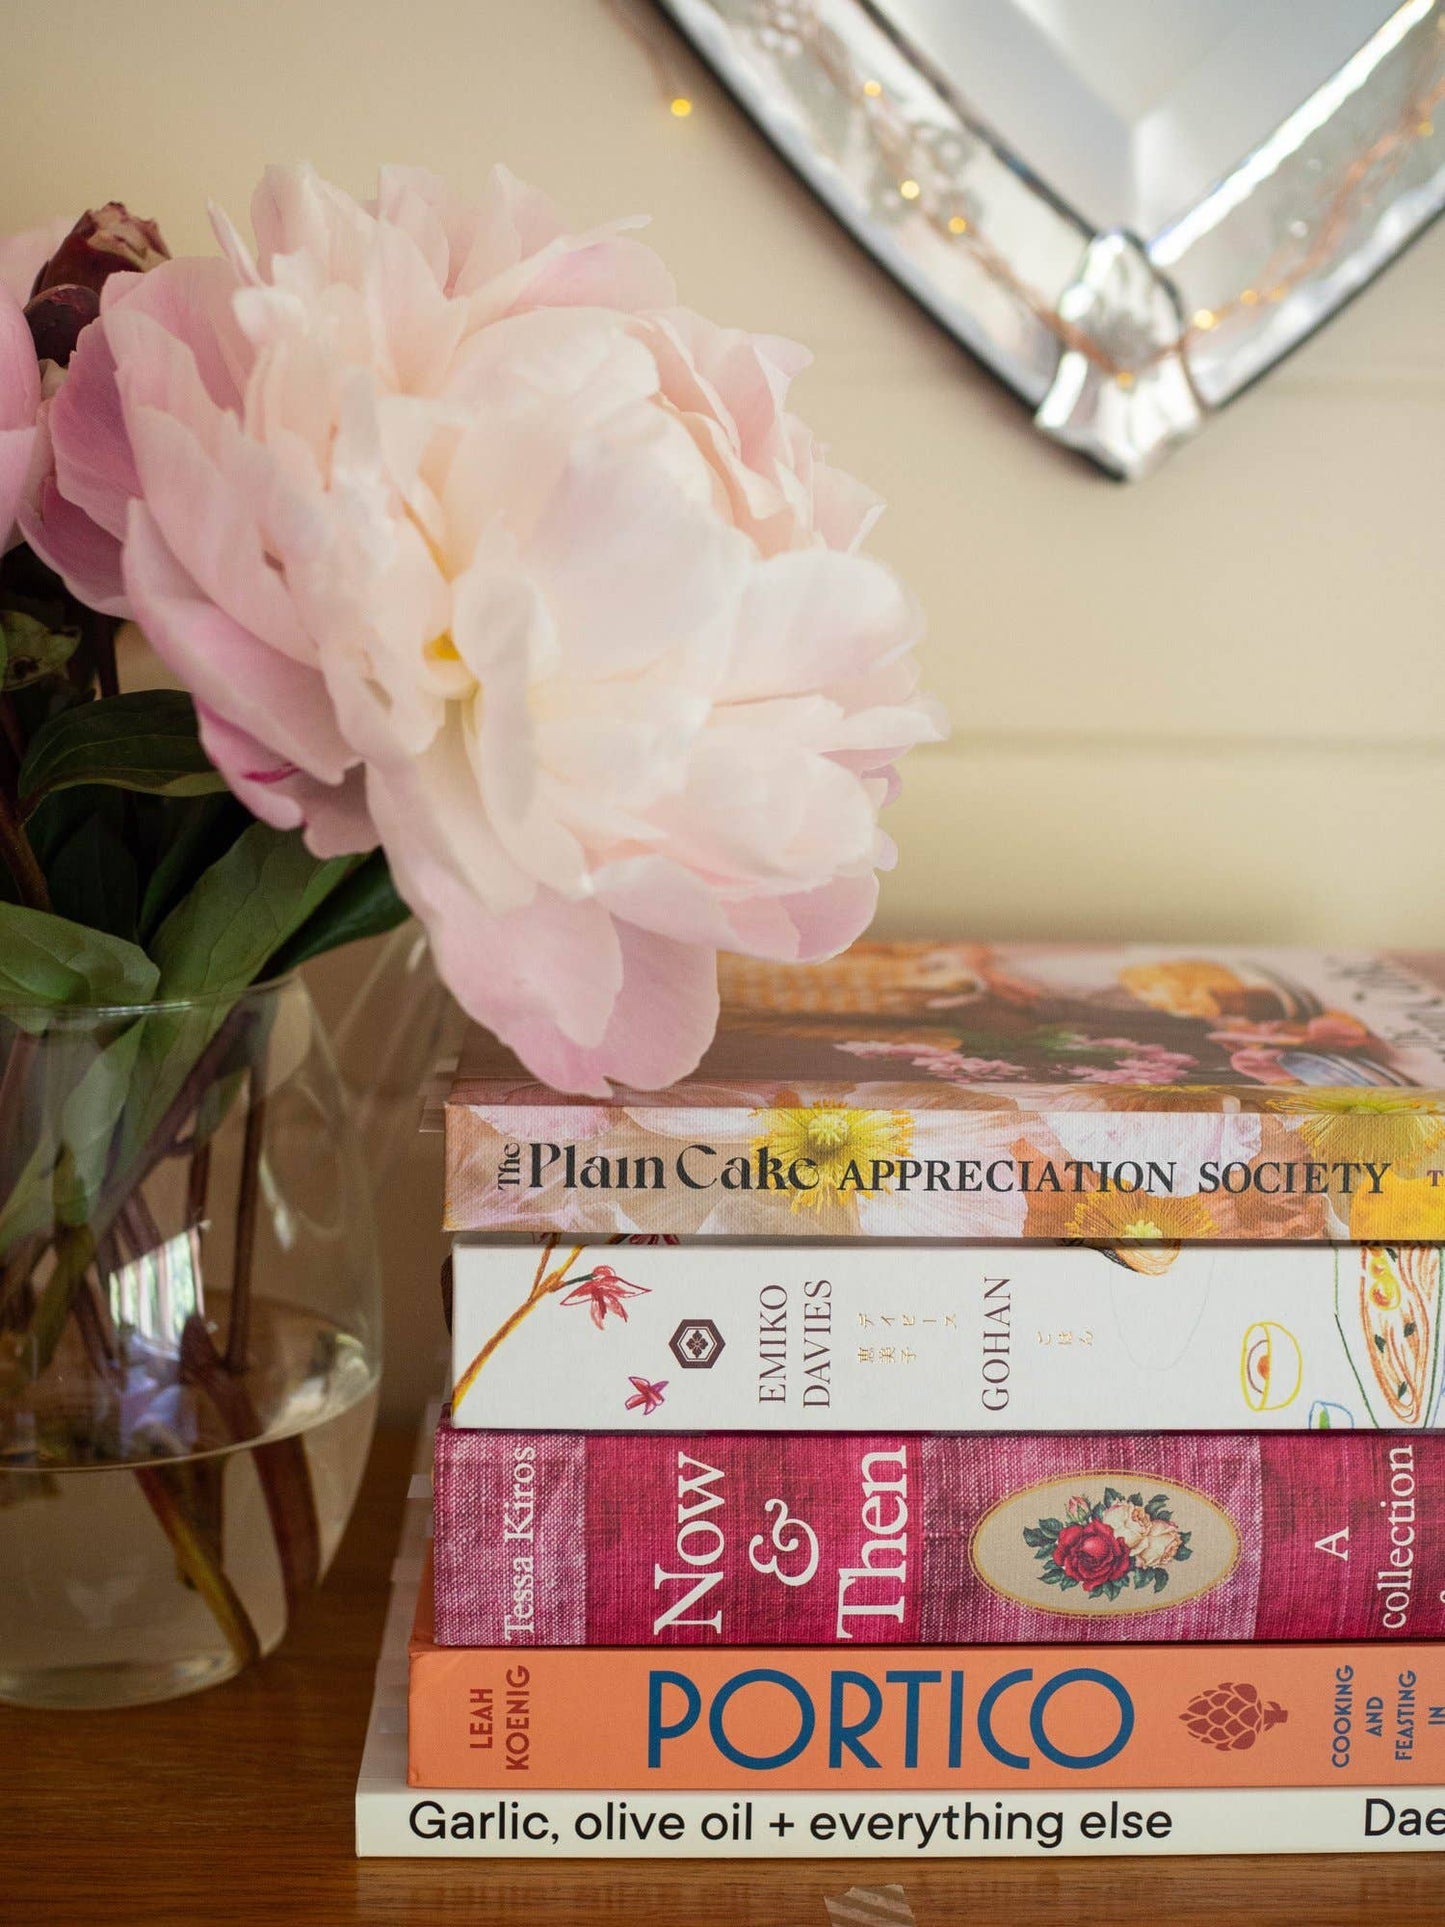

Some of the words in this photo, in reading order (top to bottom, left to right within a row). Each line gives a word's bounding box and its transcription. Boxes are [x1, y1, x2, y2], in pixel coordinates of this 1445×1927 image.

[498, 1142, 520, 1190] The
[529, 1142, 666, 1189] Plain
[676, 1144, 820, 1191] Cake
[837, 1160, 1177, 1193] APPRECIATION
[1199, 1161, 1392, 1194] SOCIETY
[759, 1285, 788, 1404] EMIKO
[803, 1279, 833, 1409] DAVIES
[981, 1276, 1011, 1412] GOHAN
[1036, 1326, 1095, 1346] ごはん
[503, 1446, 536, 1542] Kiros
[1376, 1445, 1416, 1629] collection
[653, 1451, 726, 1635] Now
[748, 1498, 820, 1587] &
[836, 1446, 909, 1639] Then
[1314, 1527, 1349, 1561] A
[503, 1556, 536, 1640] Tessa
[469, 1688, 494, 1750] LEAH
[505, 1664, 531, 1771] KOENIG
[647, 1668, 1135, 1770] PORTICO
[1331, 1664, 1355, 1768] COOKING
[1365, 1696, 1384, 1737] AND
[1395, 1670, 1417, 1761] FEASTING
[1428, 1706, 1445, 1725] IN
[409, 1801, 560, 1845] Garlic,
[574, 1803, 686, 1841] olive
[701, 1802, 754, 1840] oil
[768, 1817, 796, 1840] +
[809, 1801, 1064, 1850] everything
[1080, 1800, 1173, 1839] else
[1364, 1798, 1445, 1837] Dae
